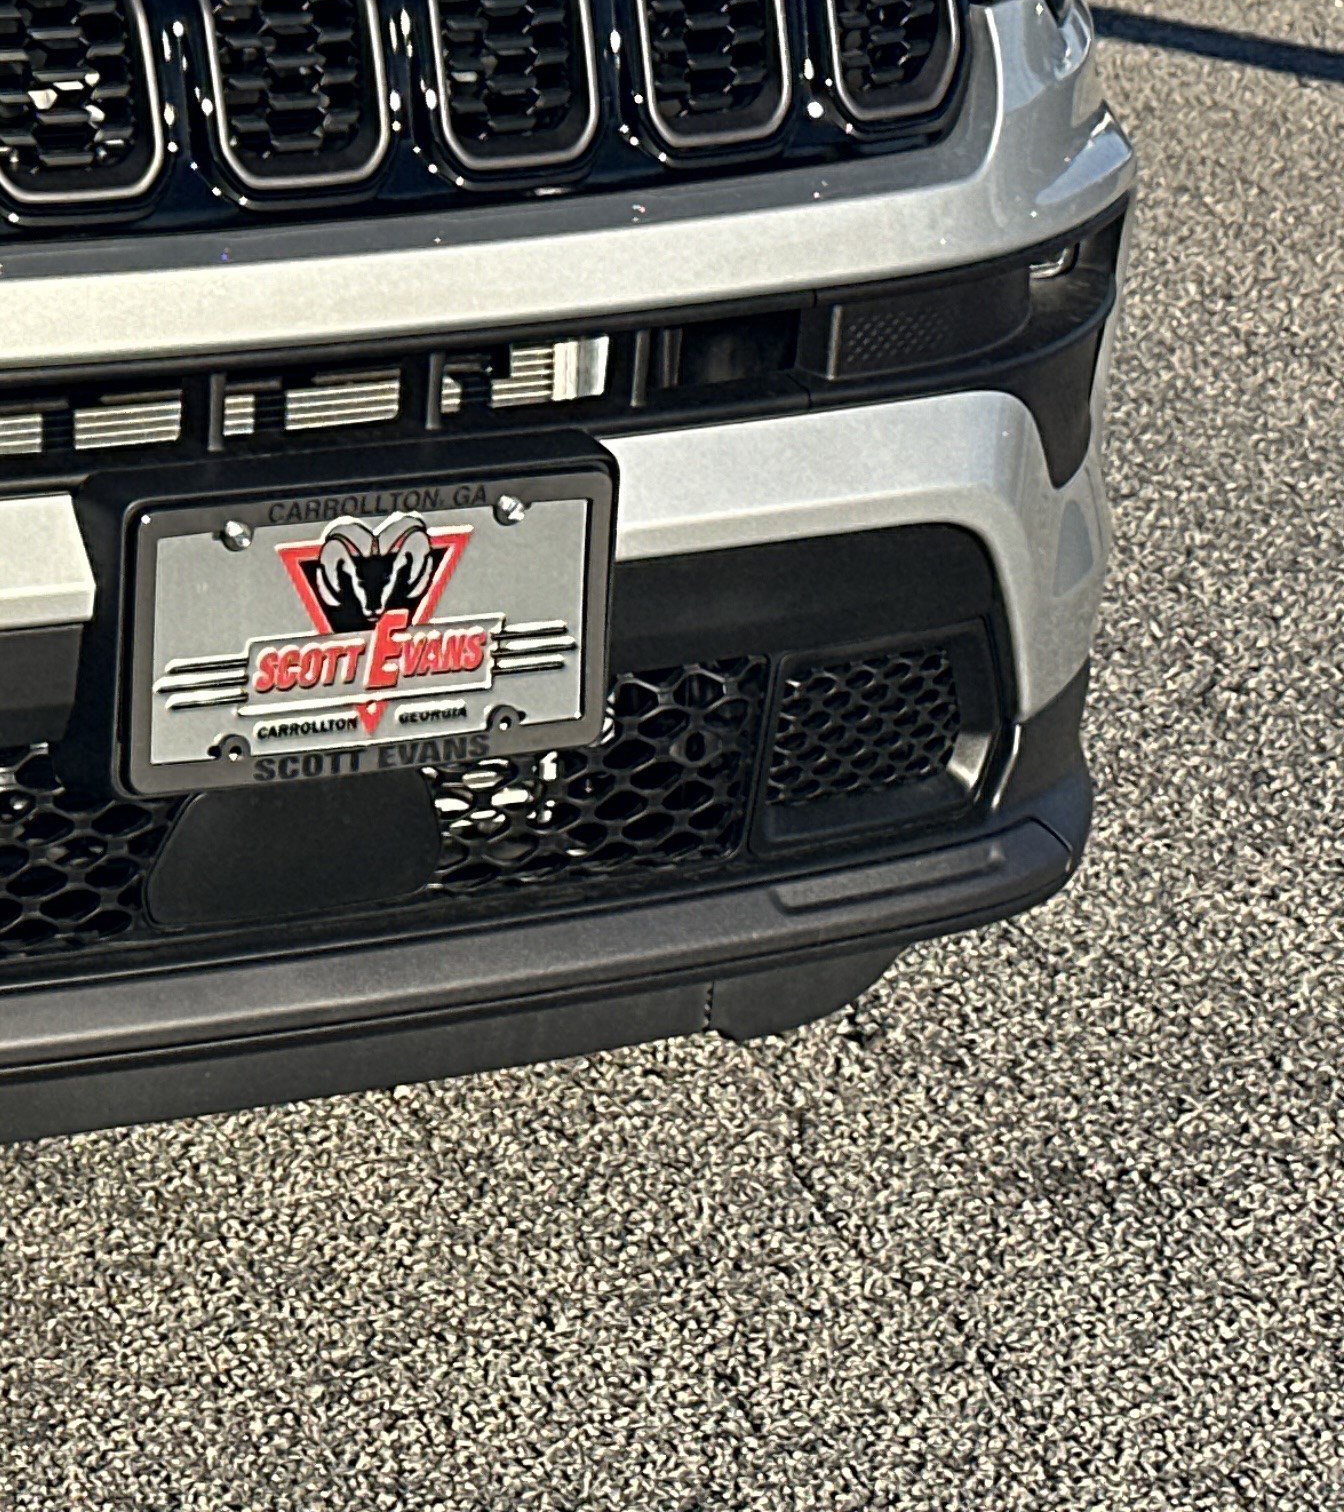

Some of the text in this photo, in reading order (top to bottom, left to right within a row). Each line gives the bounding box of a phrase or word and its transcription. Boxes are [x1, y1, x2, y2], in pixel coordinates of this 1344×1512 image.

[453, 484, 486, 505] GA
[254, 608, 488, 694] SCOTT EVANS
[256, 705, 466, 738] CARROLLTON GEORGIA
[253, 734, 489, 780] SCOTT EVANS
